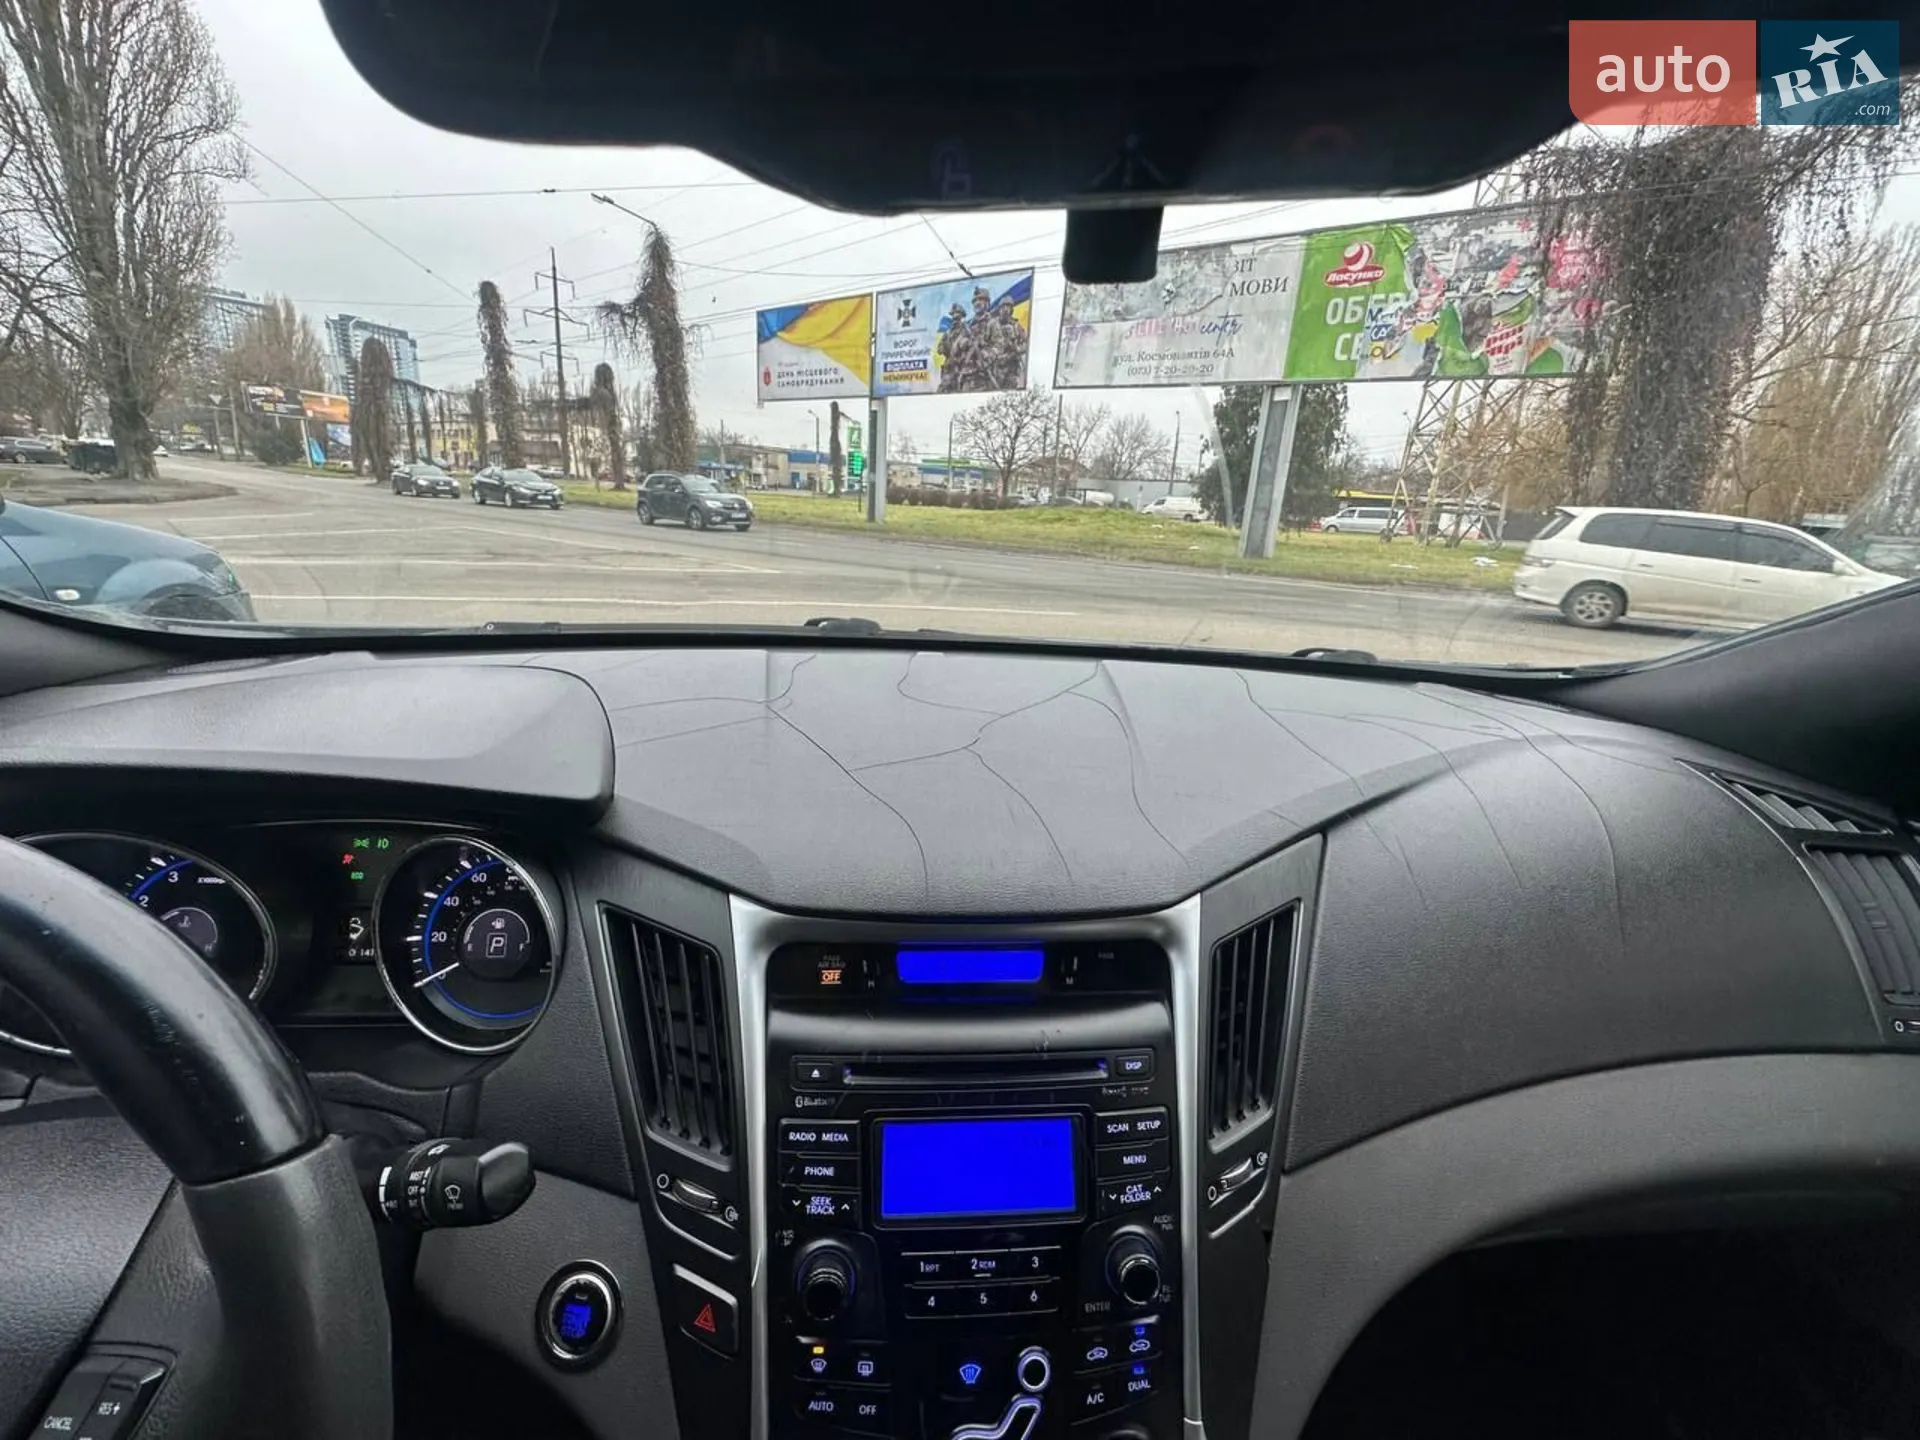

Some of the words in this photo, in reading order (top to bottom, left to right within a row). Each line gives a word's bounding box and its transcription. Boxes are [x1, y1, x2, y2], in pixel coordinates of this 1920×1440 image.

[1229, 276, 1289, 297] МОВИ
[777, 371, 795, 379] ДЕНЬ
[796, 367, 839, 378] МІСЦЕВОГО
[168, 871, 179, 883] 3
[471, 872, 487, 883] 60
[139, 895, 149, 908] 2
[444, 896, 460, 907] 40
[431, 932, 447, 943] 20
[489, 937, 505, 953] P
[822, 972, 841, 982] OFF
[1125, 1060, 1142, 1071] DISP
[1107, 1123, 1129, 1133] SCAN
[1136, 1120, 1161, 1131] SETUP
[788, 1132, 816, 1142] RADIO
[821, 1133, 849, 1142] MEDIA
[1122, 1155, 1147, 1165] MENU
[804, 1166, 835, 1177] PHONE
[1125, 1184, 1143, 1193] CAT
[810, 1196, 831, 1205] SEEK
[1120, 1191, 1151, 1204] FOLDER
[805, 1205, 835, 1215] TRACK
[1031, 1256, 1039, 1268] 3
[927, 1296, 935, 1307] 4
[980, 1292, 987, 1304] 5
[1030, 1290, 1038, 1302] 6
[1084, 1302, 1110, 1313] ENTER
[1128, 1379, 1151, 1391] DUAL
[1086, 1392, 1105, 1405] A/C
[808, 1401, 834, 1412] AUTO
[859, 1405, 877, 1415] OFF
[44, 1415, 72, 1431] CANCEL
